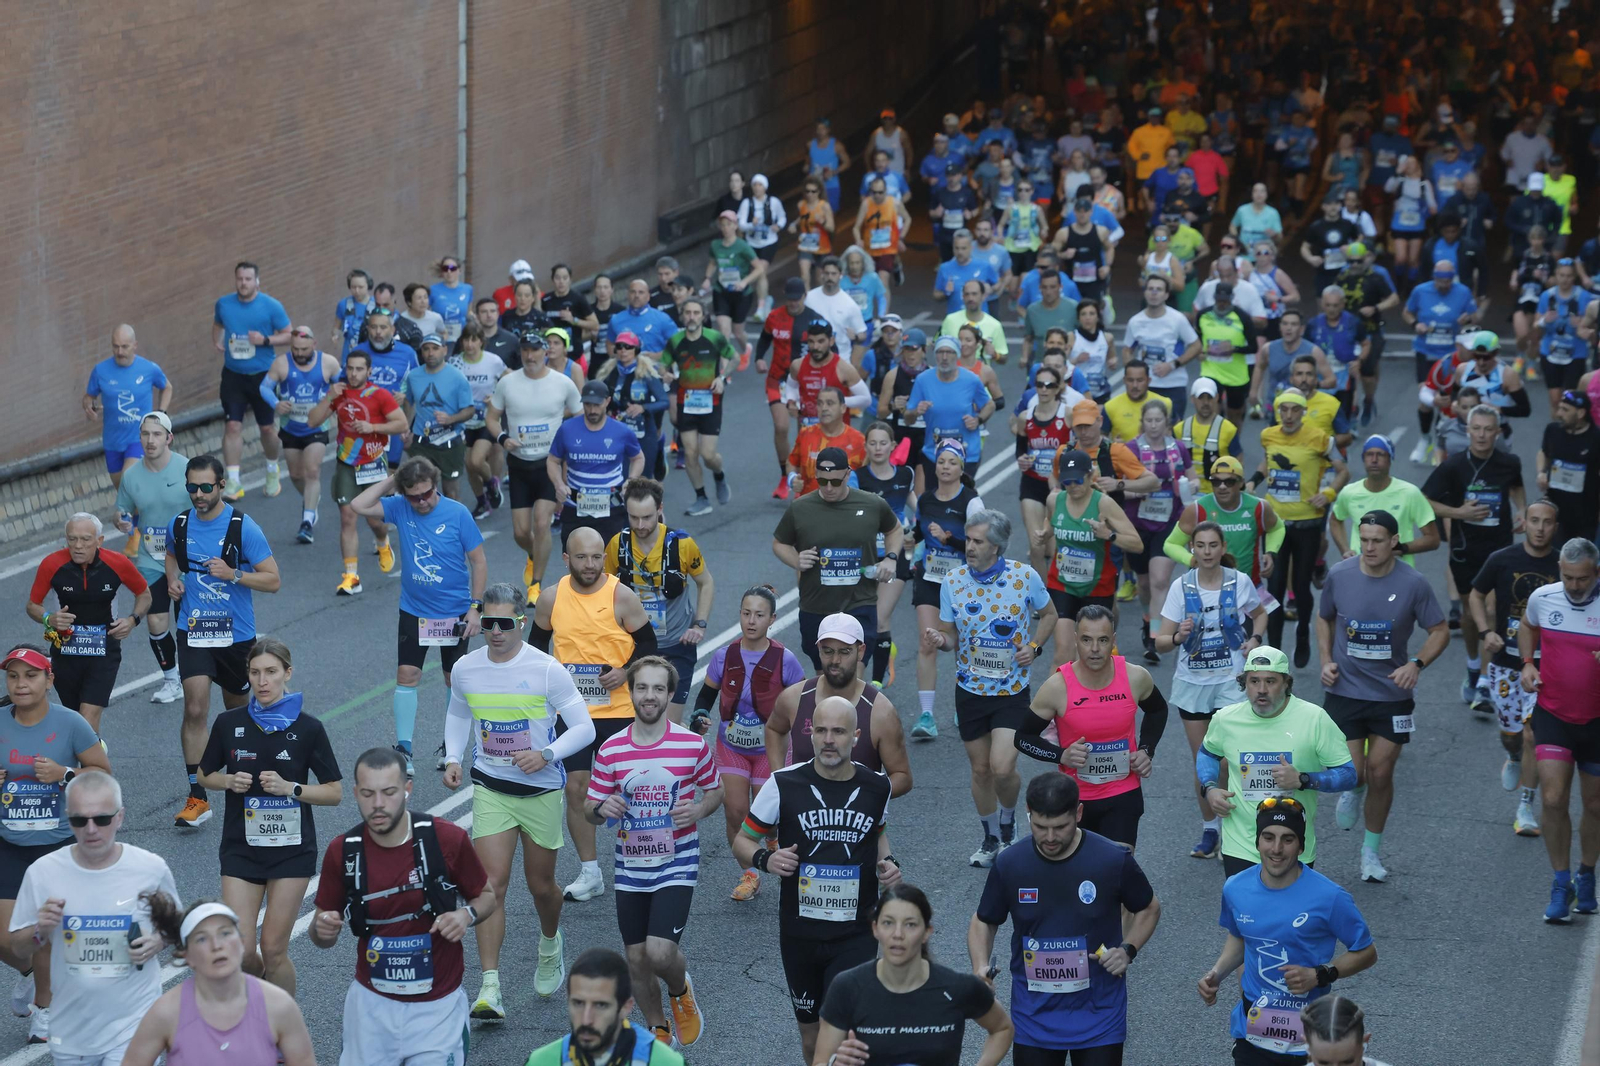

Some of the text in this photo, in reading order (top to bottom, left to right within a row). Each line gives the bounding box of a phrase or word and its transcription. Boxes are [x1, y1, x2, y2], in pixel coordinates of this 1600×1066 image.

[1054, 528, 1096, 542] PORTUGAL
[428, 629, 453, 637] PETER
[1202, 639, 1224, 648] ZURICH
[1347, 641, 1368, 649] GEORGE
[974, 658, 1005, 669] MANUEL
[1188, 657, 1232, 669] JESS PERRY
[578, 687, 607, 695] RARDO
[1099, 694, 1127, 702] PICHA
[727, 734, 761, 746] CLAUDIA
[1096, 743, 1124, 751] ZURICH
[1089, 765, 1118, 773] PICHA
[8, 806, 53, 819] NATÁLIA
[634, 819, 665, 828] ZURICH
[798, 808, 874, 832] KENIATAS
[259, 824, 287, 834] SARA
[812, 830, 858, 843] PACENSES
[625, 842, 670, 855] RAPHAËL
[800, 896, 858, 908] JOAO PRIETO
[85, 919, 124, 928] ZURICH
[387, 939, 423, 949] ZURICH
[1043, 940, 1078, 949] ZURICH
[79, 950, 113, 962] JOHN
[385, 968, 416, 980] LIAM
[1035, 968, 1078, 979] ENDANI
[1272, 998, 1308, 1009] ZURICH
[1271, 1016, 1290, 1025] 8661
[856, 1024, 955, 1034] FAVOURITE MAGISTRATE
[1262, 1027, 1298, 1041] JMBR
